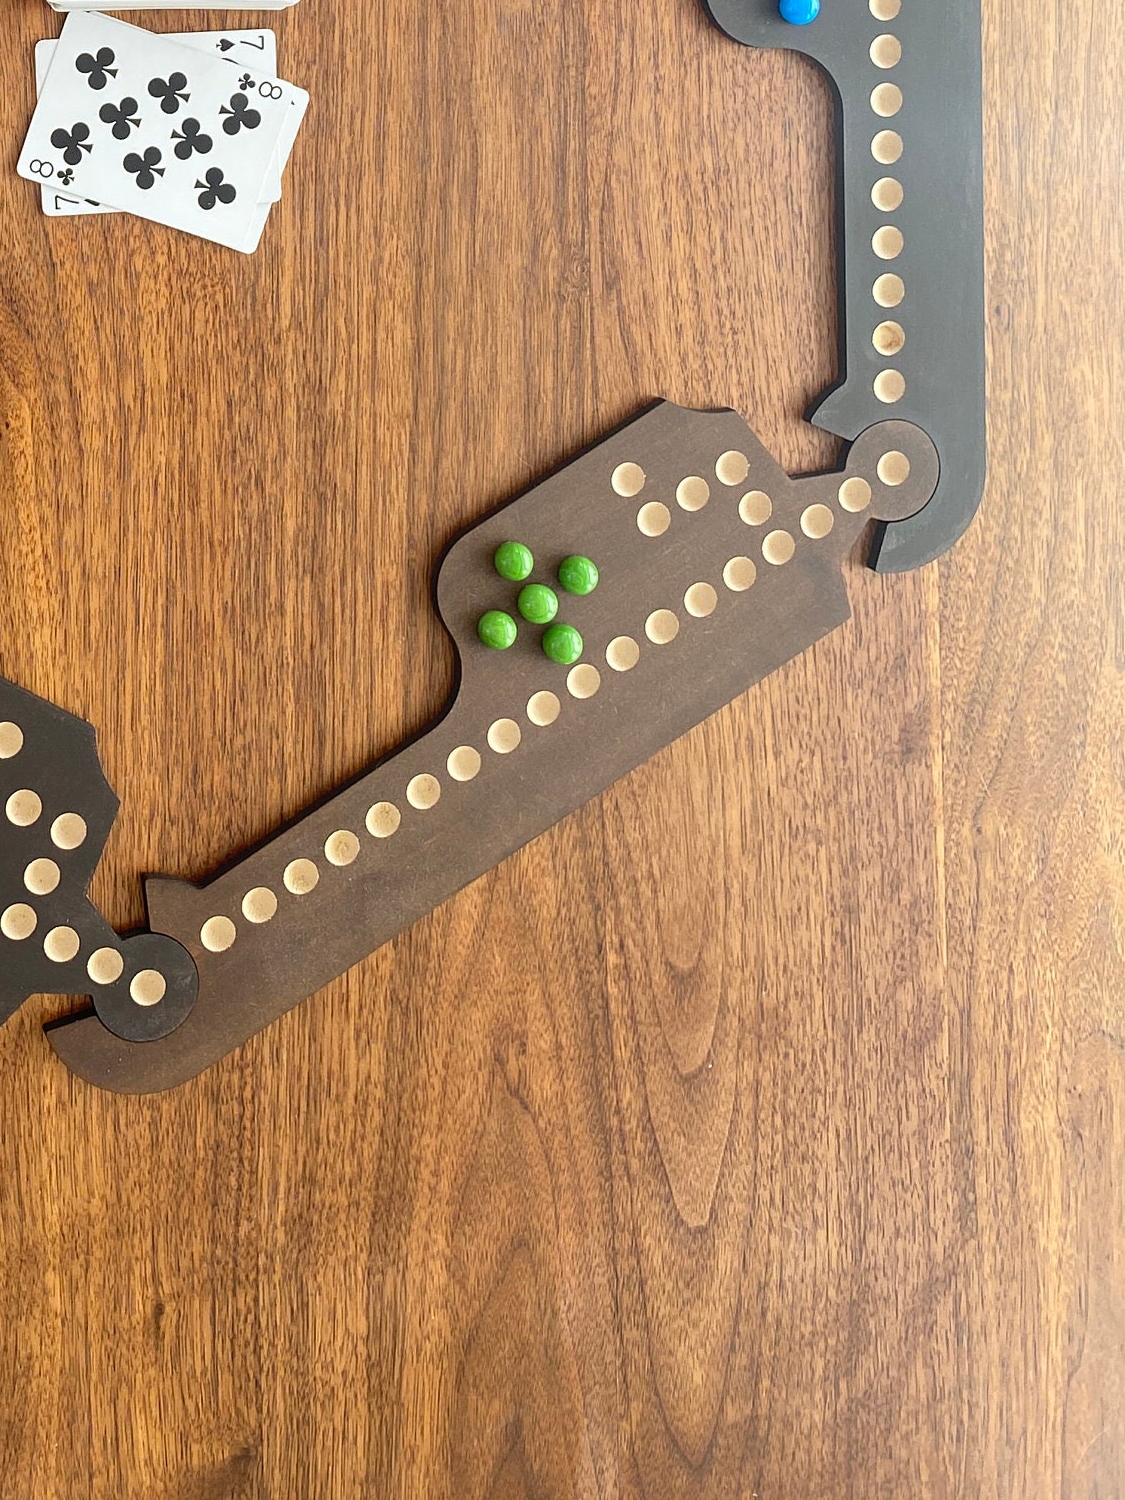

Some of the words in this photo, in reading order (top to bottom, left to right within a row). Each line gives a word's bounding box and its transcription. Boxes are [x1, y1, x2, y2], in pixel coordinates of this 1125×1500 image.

[239, 35, 265, 50] 7
[258, 81, 283, 100] 8
[29, 158, 54, 178] 8
[54, 194, 80, 210] 7
